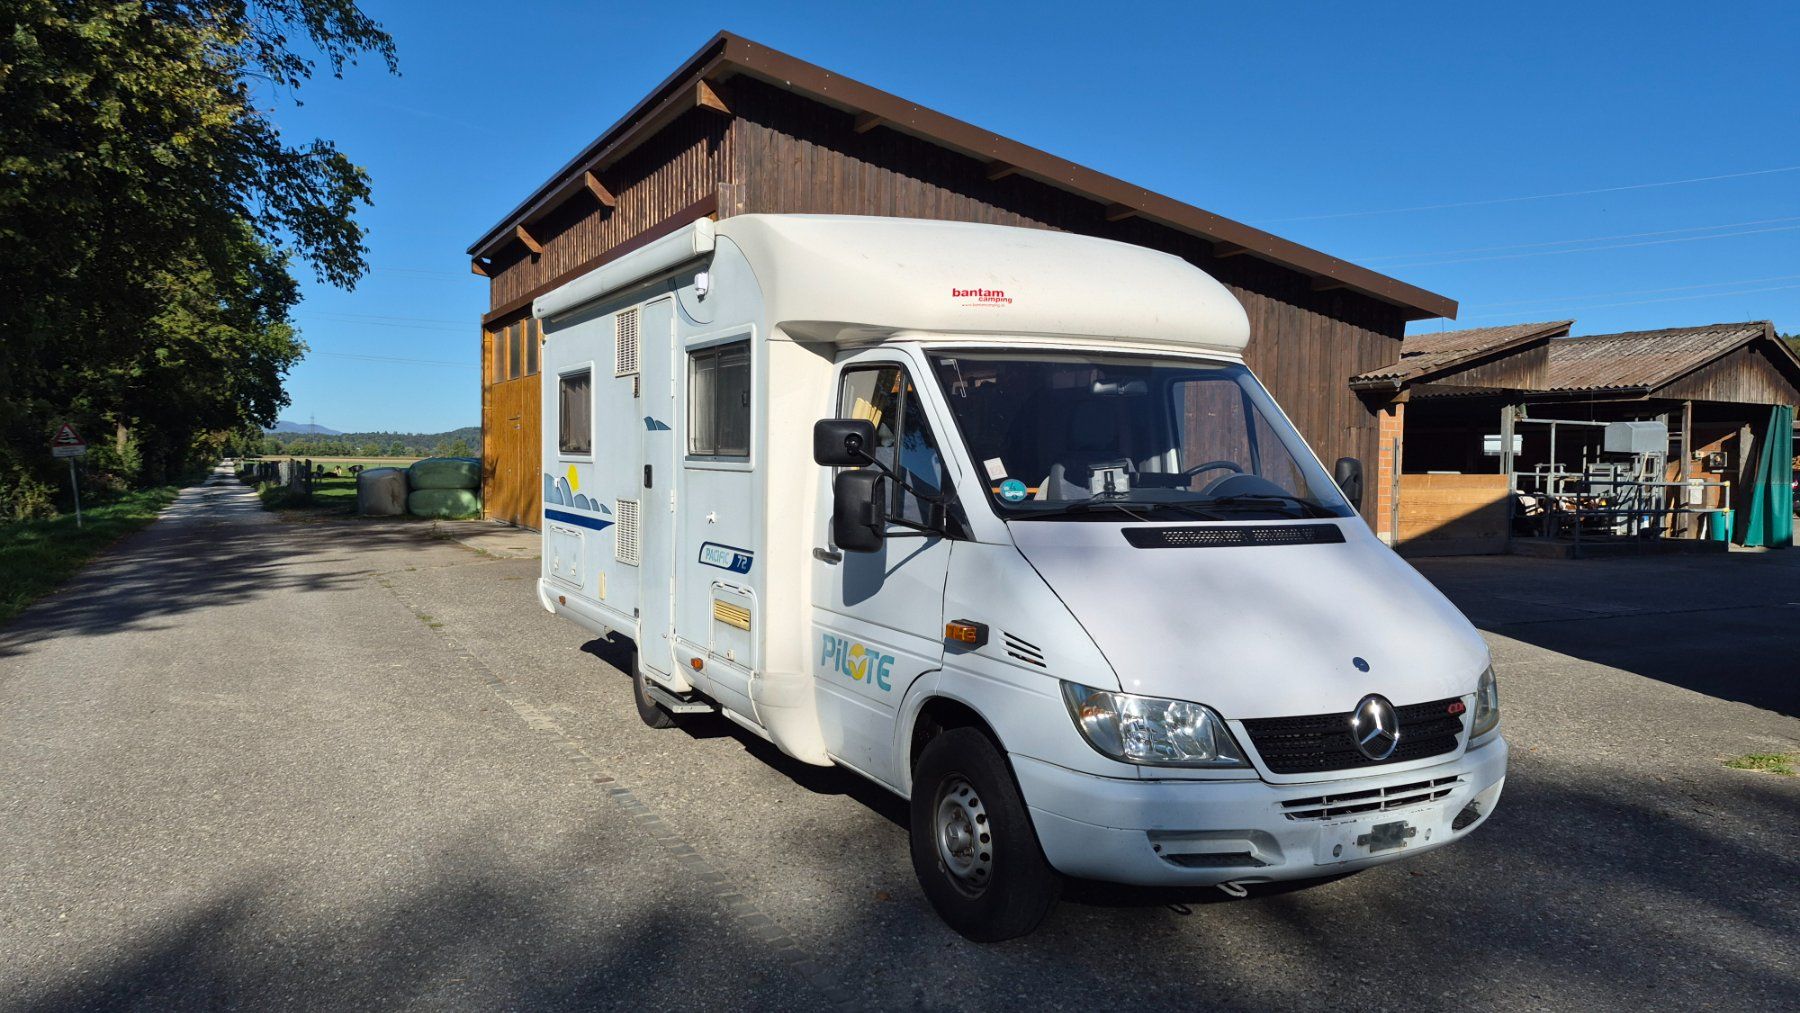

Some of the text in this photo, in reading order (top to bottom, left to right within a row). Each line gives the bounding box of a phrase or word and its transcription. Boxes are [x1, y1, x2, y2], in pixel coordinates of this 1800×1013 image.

[952, 288, 1004, 297] bantam
[705, 548, 748, 570] PACIFIC 72
